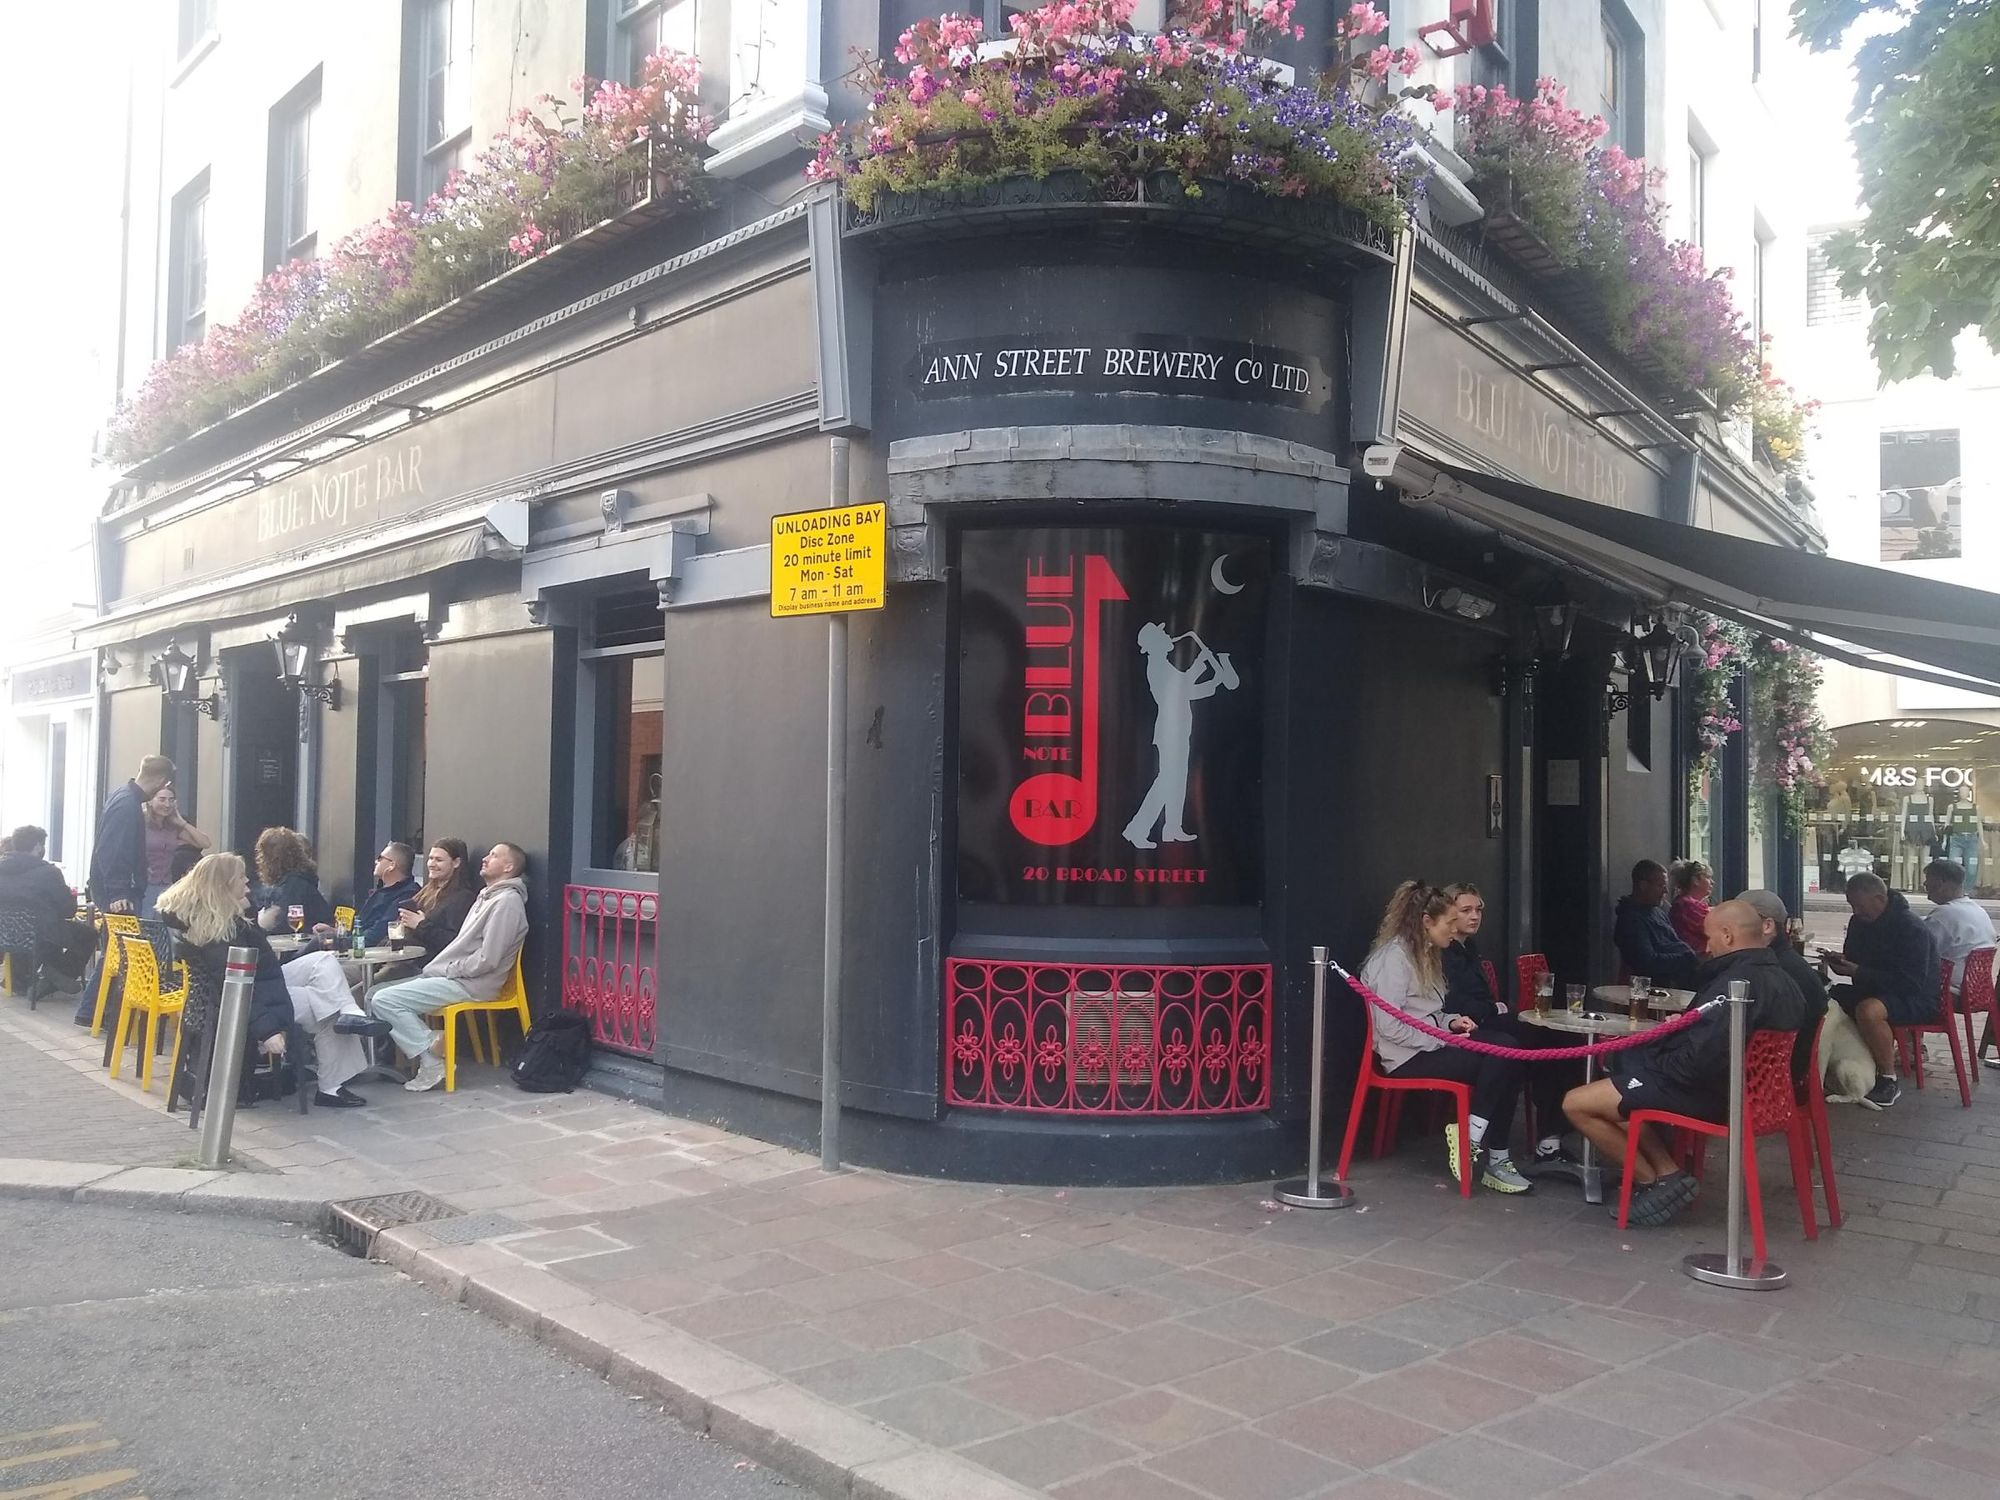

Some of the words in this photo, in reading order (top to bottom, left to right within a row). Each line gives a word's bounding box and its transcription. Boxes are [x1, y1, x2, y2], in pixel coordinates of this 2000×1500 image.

[923, 353, 984, 385] ANN
[993, 348, 1092, 379] STREET
[1102, 348, 1225, 381] BREWERY
[1530, 407, 1587, 492] NOTE
[1592, 450, 1628, 509] BAR
[257, 485, 305, 542] BLUE
[309, 463, 368, 527] NOTE
[375, 445, 424, 501] BAR
[776, 513, 851, 535] UNLOADING
[856, 509, 881, 526] BAY
[800, 536, 824, 549] Disc
[827, 533, 855, 546] Zone
[783, 553, 799, 567] 20
[802, 550, 841, 566] minute
[845, 546, 872, 561] limit
[800, 569, 824, 582] Mon
[833, 565, 854, 579] Sat
[789, 588, 797, 601] 7
[801, 589, 818, 600] am
[833, 584, 841, 597] 11
[846, 584, 864, 596] am
[800, 602, 824, 610] business
[824, 600, 840, 608] name
[841, 598, 853, 606] and
[853, 597, 877, 605] address
[1024, 554, 1074, 737] BLUE
[1023, 746, 1073, 761] NOTE
[1860, 766, 1918, 787] M&S
[1024, 799, 1082, 820] BAR
[1023, 866, 1049, 881] 20
[1056, 867, 1127, 882] BROAD
[1133, 868, 1208, 883] STREET
